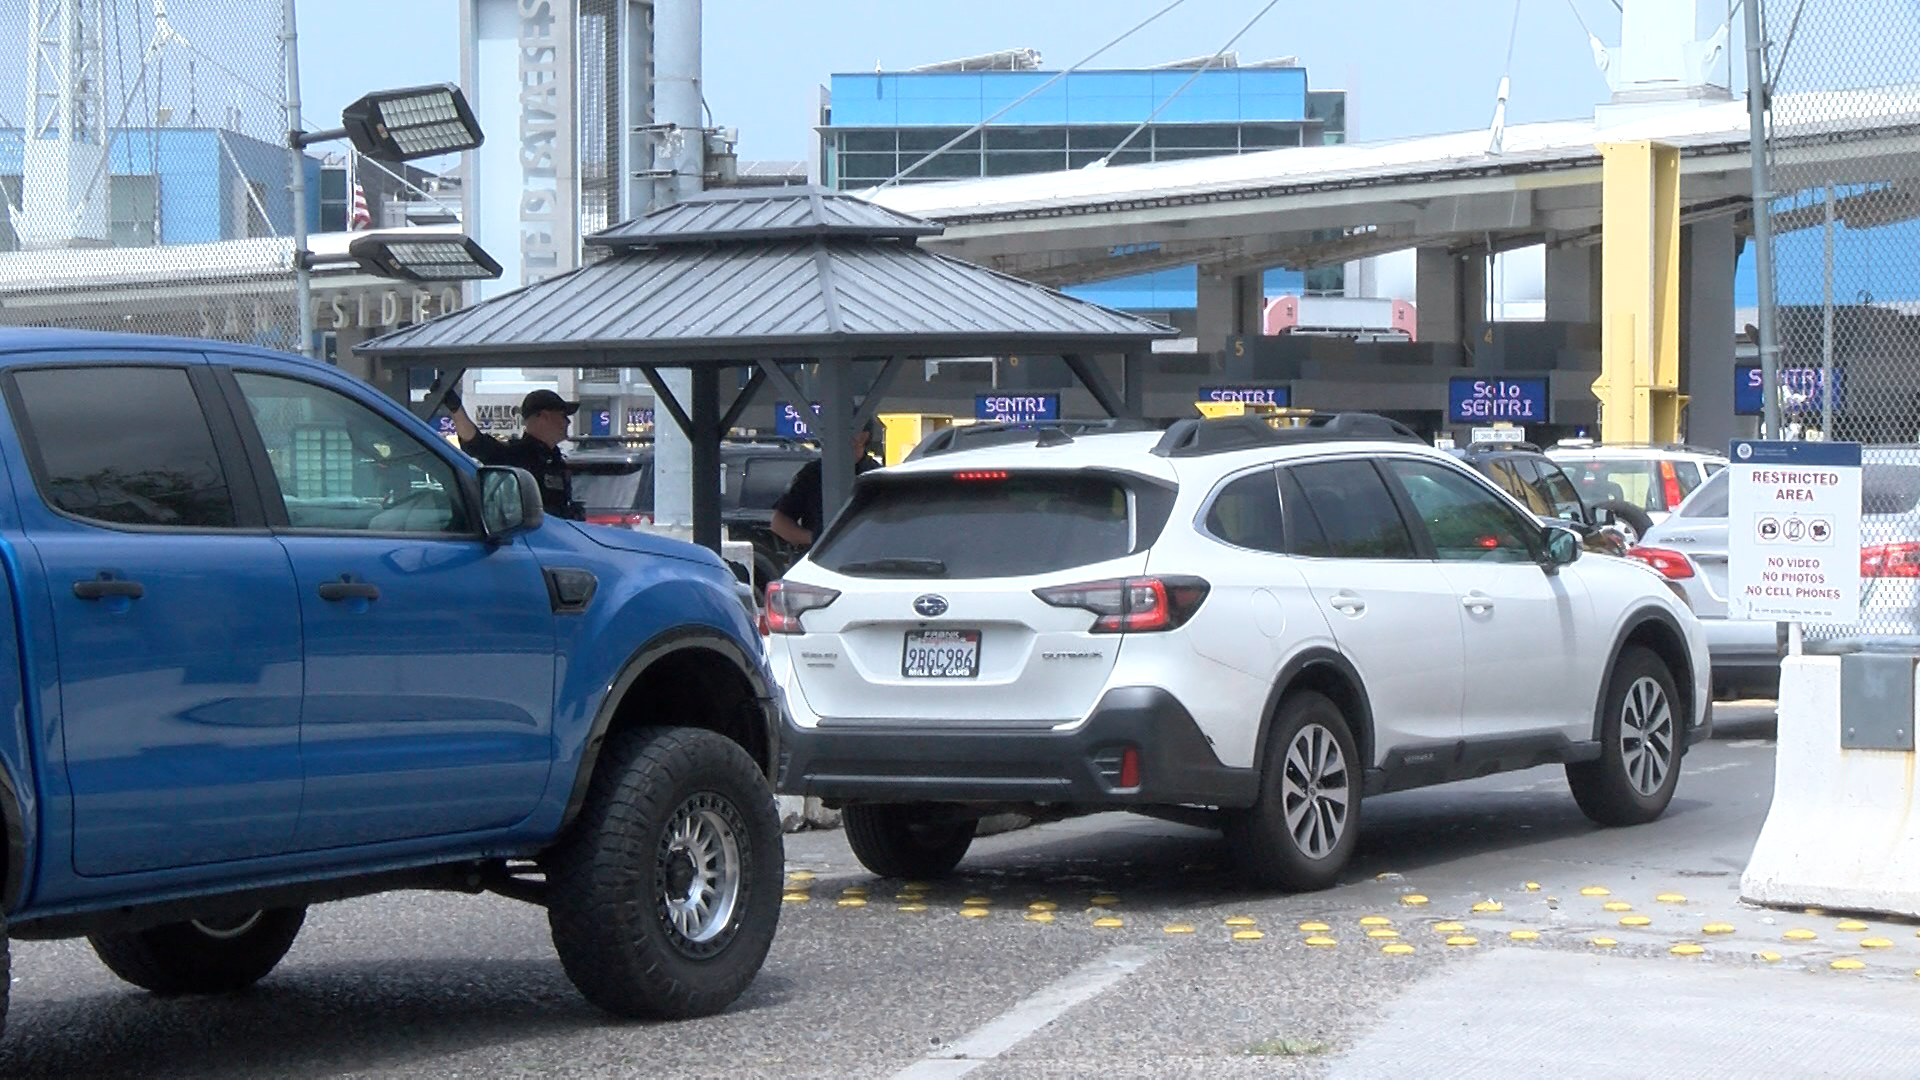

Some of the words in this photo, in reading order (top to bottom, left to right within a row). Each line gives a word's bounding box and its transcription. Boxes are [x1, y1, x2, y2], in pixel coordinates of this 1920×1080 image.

[1235, 341, 1244, 356] 5
[1749, 368, 1824, 387] SNTRI
[1210, 389, 1275, 404] SENTRI
[1473, 381, 1520, 398] Solo
[985, 396, 1046, 412] SENTRI
[1461, 399, 1533, 416] SENTRI
[1752, 471, 1839, 485] RESTRICTED
[1776, 489, 1814, 501] AREA
[1768, 558, 1784, 567] NO
[1787, 559, 1820, 569] VIDEO
[1762, 572, 1778, 581] NO
[1781, 573, 1825, 584] PHOTOS
[1746, 585, 1762, 596] NO
[1765, 587, 1791, 596] CELL
[1796, 588, 1840, 599] PHONES
[908, 648, 974, 670] 9BGC986
